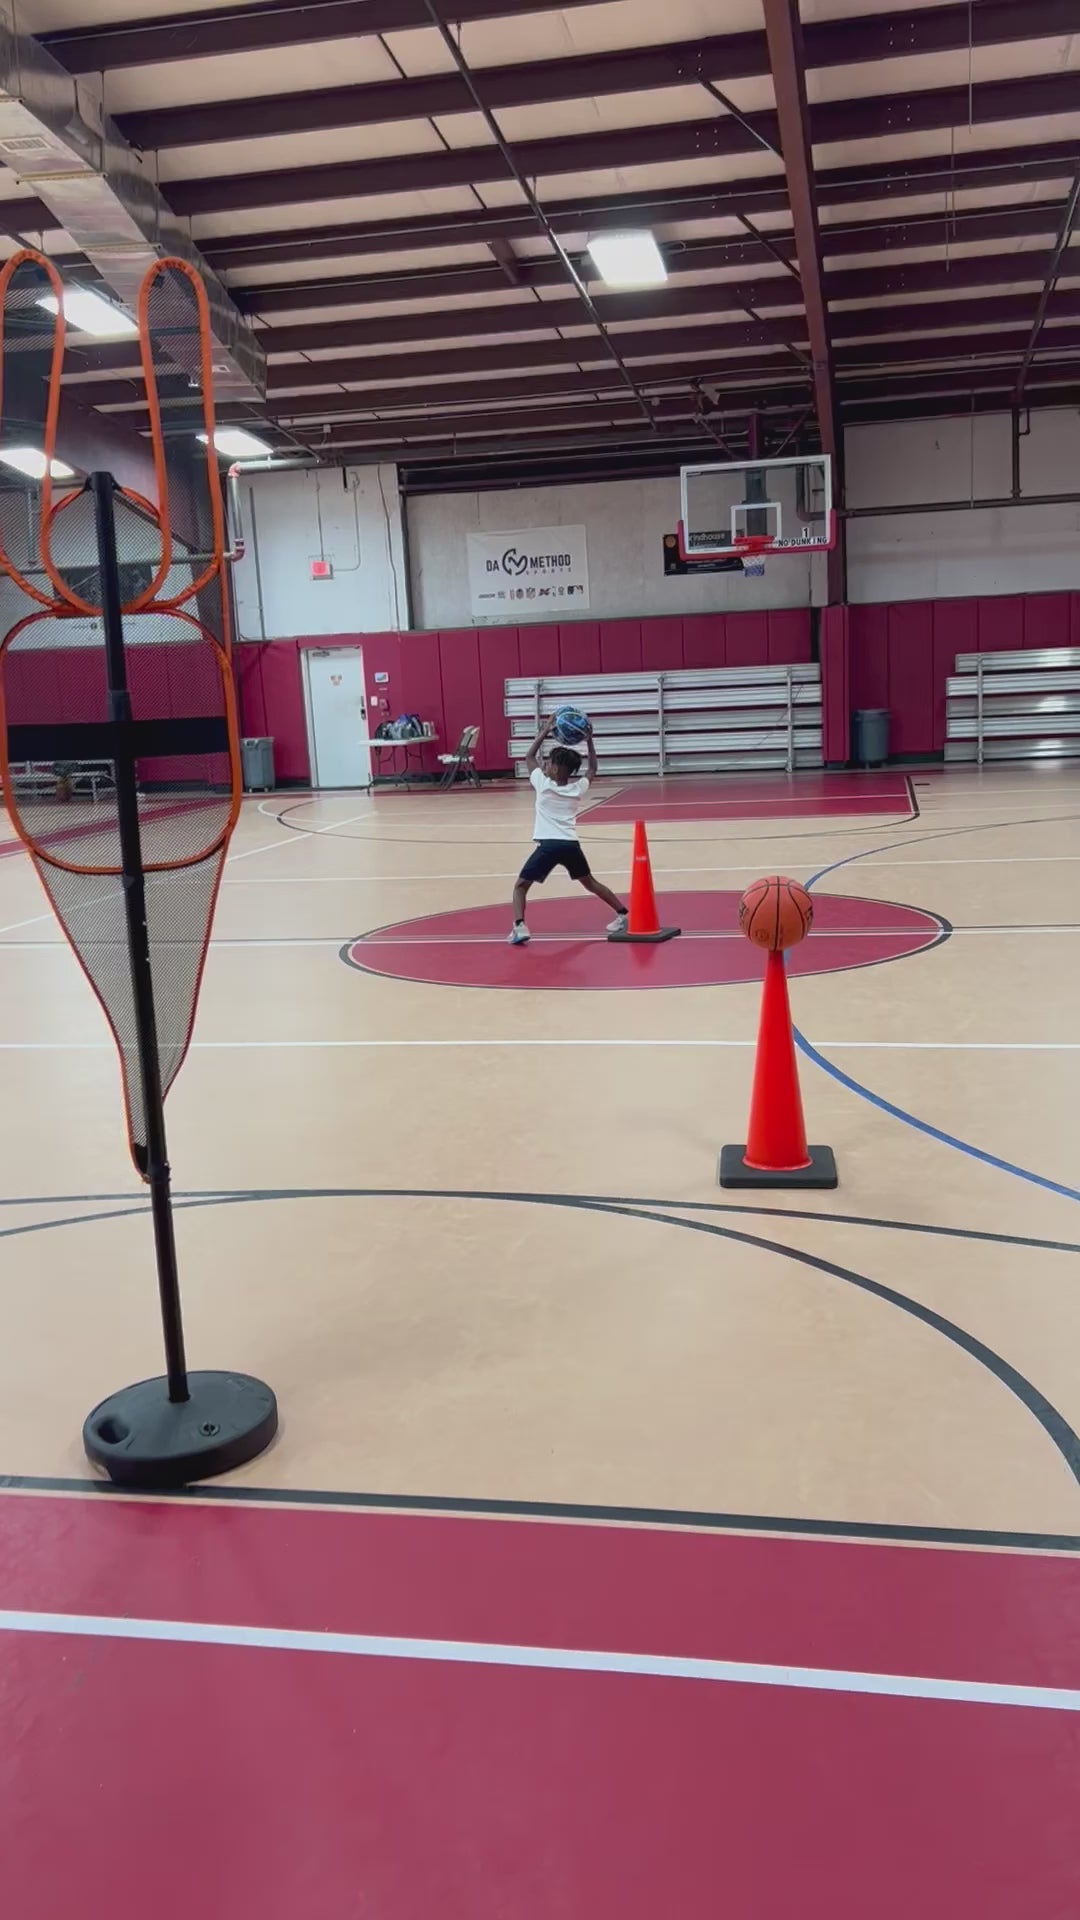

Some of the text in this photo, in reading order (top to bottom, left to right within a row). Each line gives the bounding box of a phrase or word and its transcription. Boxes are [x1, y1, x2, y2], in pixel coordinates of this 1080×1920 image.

[778, 537, 828, 547] NO DUNKING
[486, 560, 499, 571] DA
[530, 554, 571, 568] METHOD
